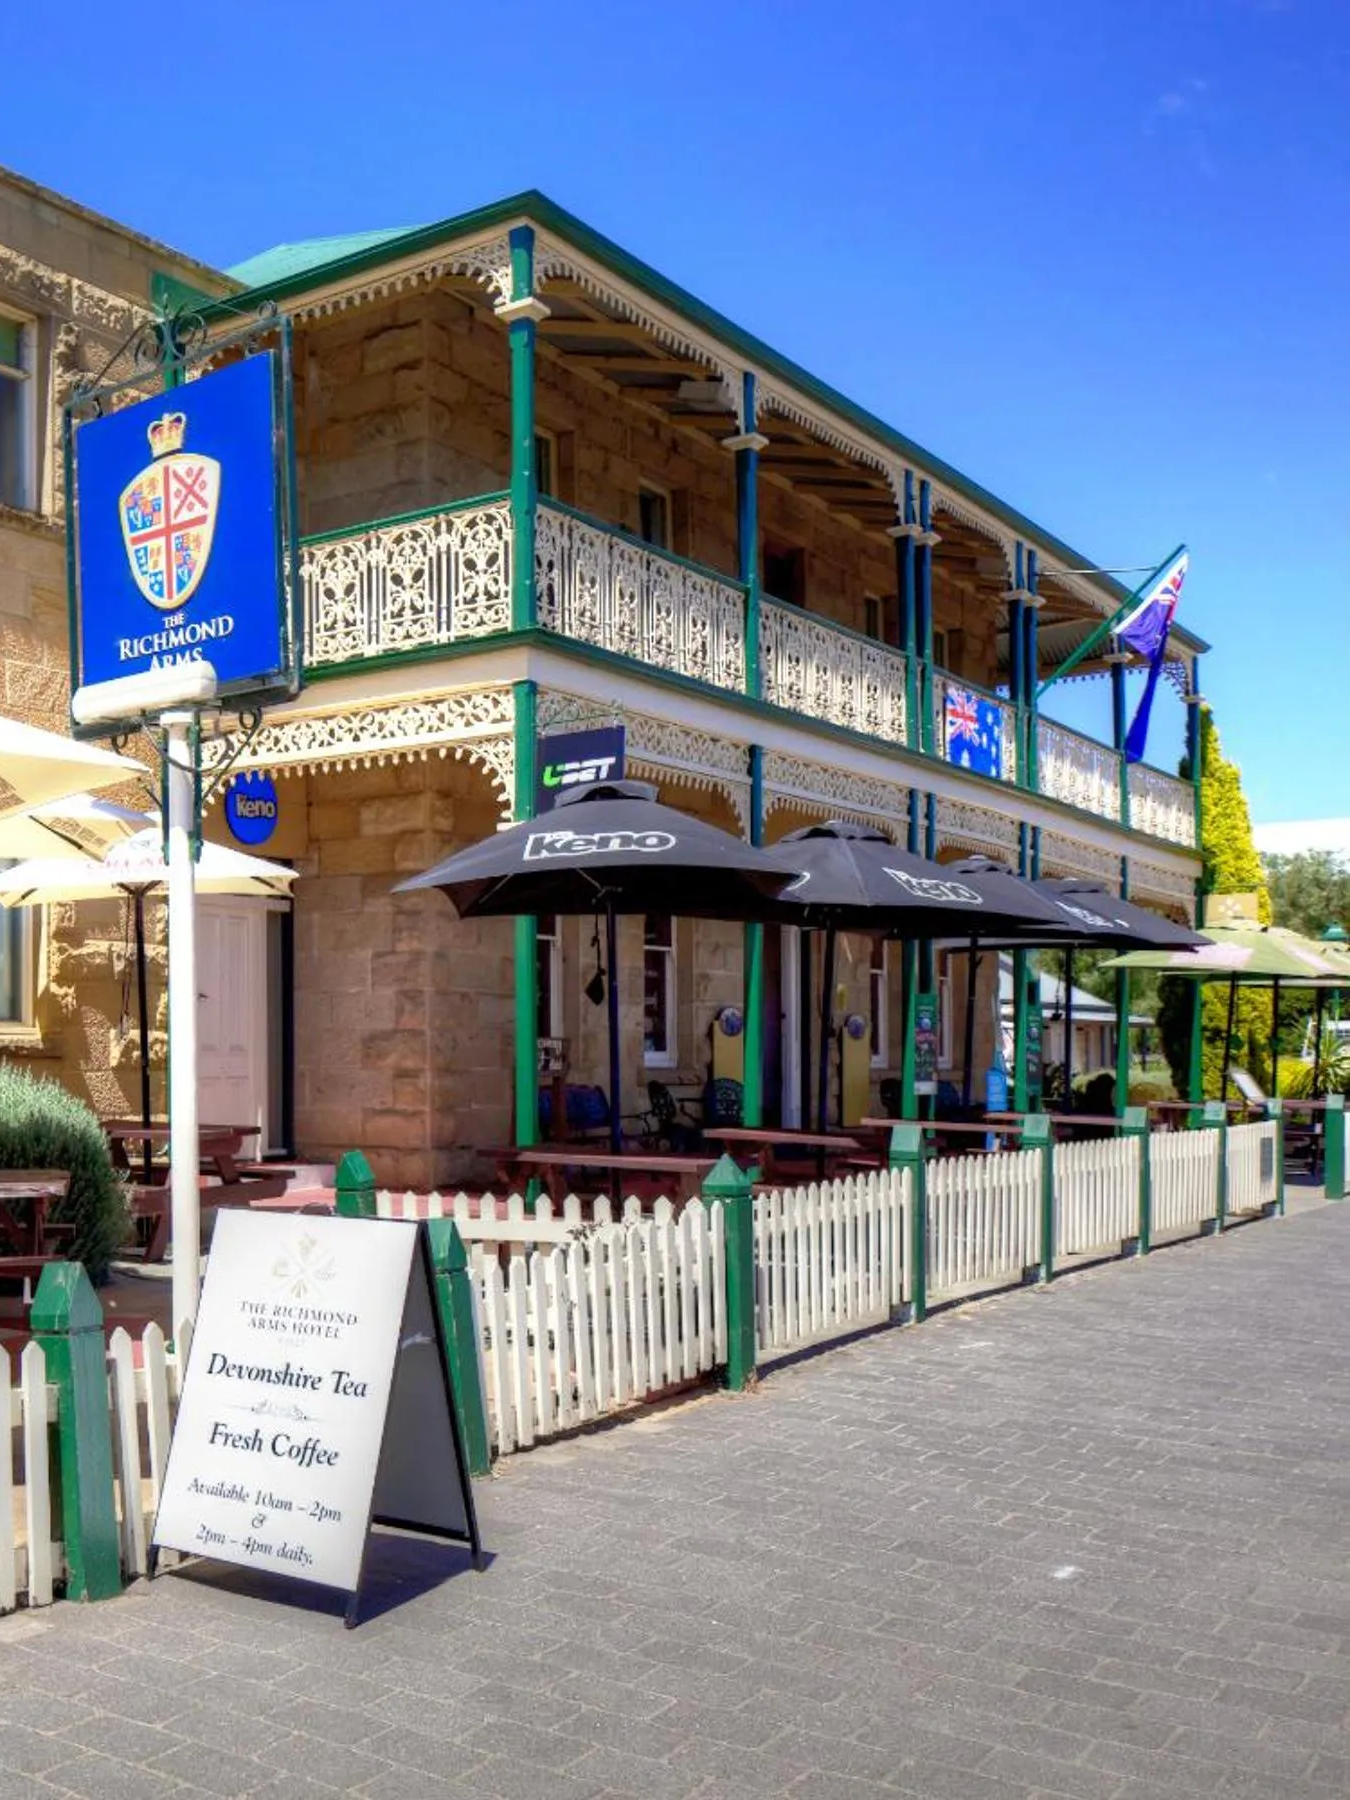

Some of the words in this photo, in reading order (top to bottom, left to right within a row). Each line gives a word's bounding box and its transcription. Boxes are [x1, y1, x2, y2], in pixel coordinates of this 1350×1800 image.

[162, 612, 186, 629] THE
[119, 614, 235, 661] RICHMOND
[150, 647, 203, 670] ARMS
[235, 793, 276, 818] Keno
[522, 830, 677, 861] Keno
[248, 1316, 288, 1332] ARMS
[292, 1320, 341, 1339] HOTEL
[272, 1303, 358, 1326] RICHMOND
[207, 1352, 323, 1391] Devonshire
[331, 1369, 369, 1398] Tea
[209, 1421, 264, 1453] Fresh
[271, 1432, 340, 1468] Coffee
[188, 1476, 250, 1503] Available
[254, 1489, 293, 1512] 10am
[309, 1500, 342, 1523] 2pm
[251, 1512, 267, 1529] &
[196, 1523, 226, 1545] 2pm
[241, 1536, 273, 1557] 4pm
